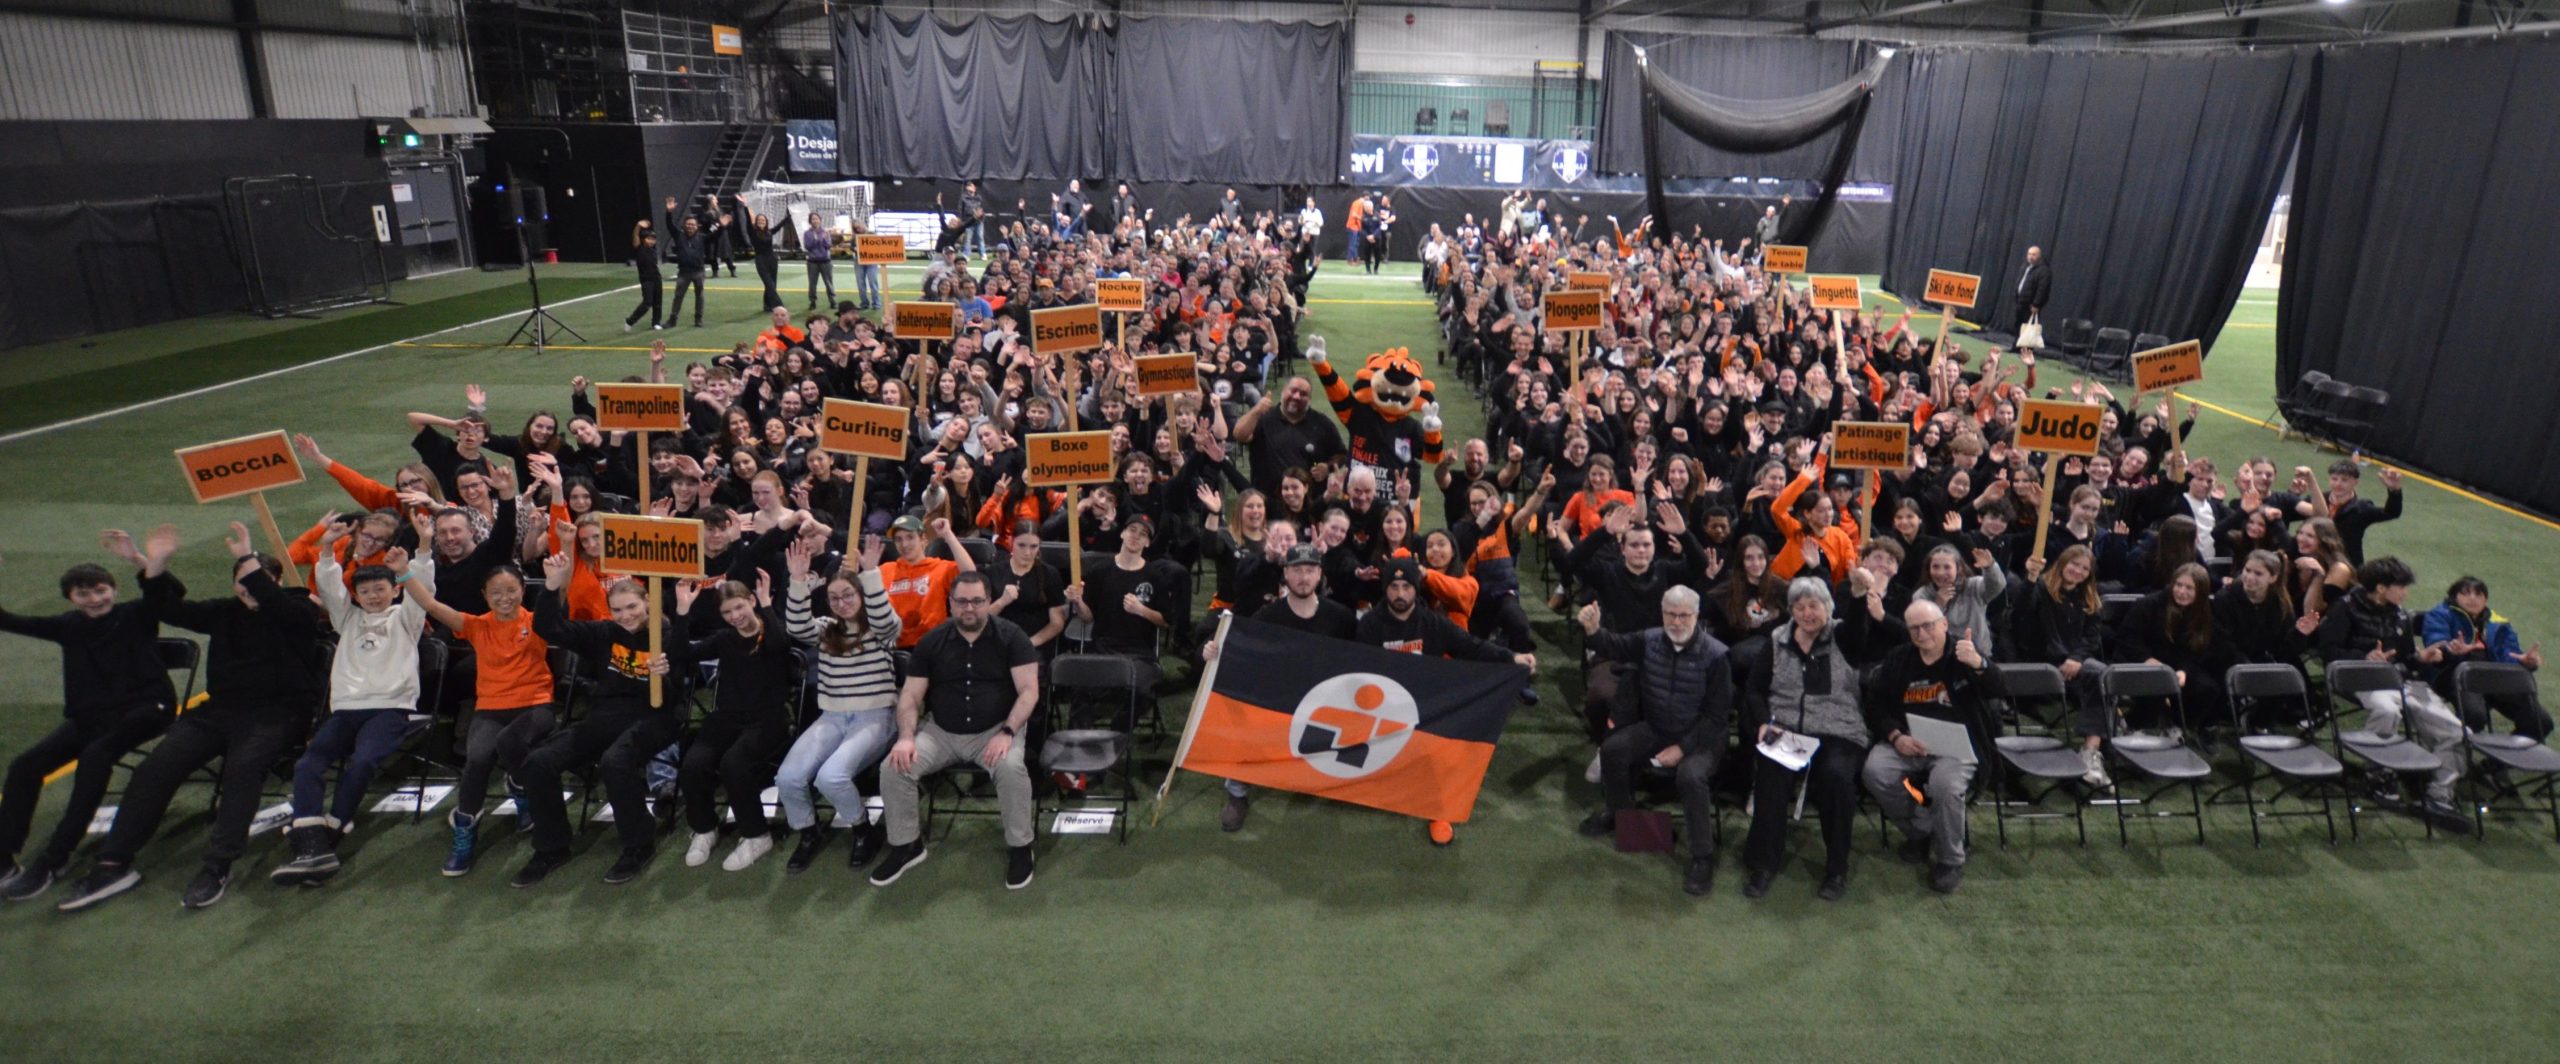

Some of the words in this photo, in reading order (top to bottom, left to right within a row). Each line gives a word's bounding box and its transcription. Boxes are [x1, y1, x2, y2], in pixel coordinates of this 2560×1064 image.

[861, 238, 899, 247] Hockey
[859, 251, 905, 260] Masculin
[1772, 248, 1801, 256] Tennis
[1767, 260, 1778, 268] de
[1780, 260, 1803, 269] table
[1099, 282, 1141, 292] Hockey
[1813, 284, 1858, 301] Ringuette
[1929, 278, 1942, 293] Ski
[1944, 281, 1954, 296] de
[1099, 295, 1142, 305] Féminin
[1545, 301, 1600, 320] Plongeon
[896, 311, 952, 331] Haltérophilie
[1035, 321, 1098, 340] Escrime
[2136, 345, 2196, 365] Patinage
[1137, 364, 1195, 386] Gymnastique
[2160, 364, 2176, 373] de
[2145, 374, 2194, 389] vitesse
[600, 395, 680, 419] Trampoline
[826, 416, 903, 443] Curling
[1838, 425, 1902, 442] Patinage
[2021, 410, 2097, 440] Judo
[1051, 440, 1088, 452] Boxe
[1835, 449, 1904, 464] artistique
[196, 452, 288, 482] BOCCIA
[1031, 461, 1110, 477] olympique
[604, 529, 698, 564] Badminton
[1064, 815, 1103, 825] Réservé
